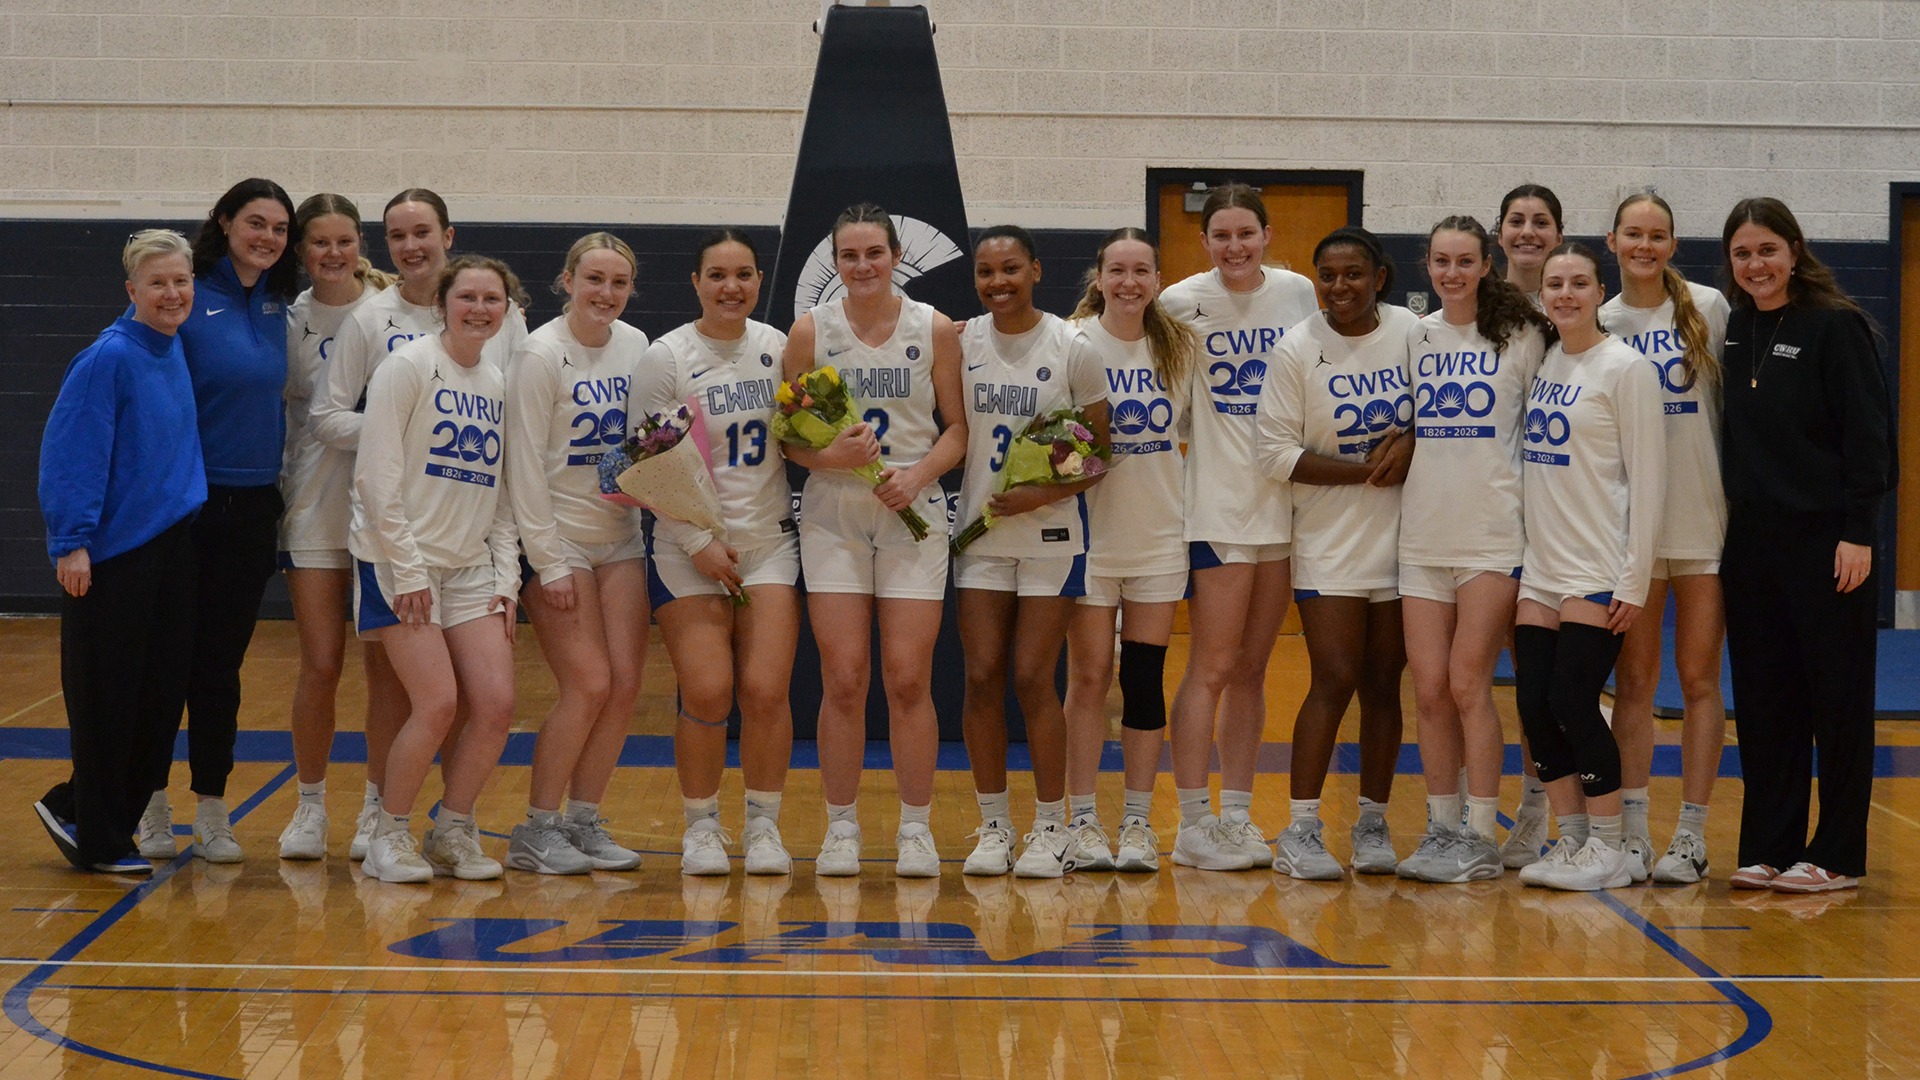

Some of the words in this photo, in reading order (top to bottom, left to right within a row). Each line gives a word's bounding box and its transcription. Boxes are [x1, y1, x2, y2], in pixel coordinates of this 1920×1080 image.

[1206, 327, 1286, 356] CWR
[1622, 328, 1688, 355] WRU
[1773, 343, 1802, 356] CWRU
[1209, 359, 1267, 396] 20
[1328, 365, 1411, 398] CWRU
[1418, 351, 1500, 378] CWRU
[434, 388, 503, 425] CWRU
[572, 374, 631, 406] CWR
[707, 378, 777, 416] CWRU
[974, 383, 1038, 417] CWRU
[1416, 381, 1496, 418] 200
[1226, 404, 1251, 414] 1826
[1334, 393, 1415, 437] 200
[1664, 404, 1682, 413] 026
[429, 420, 501, 466] 200
[569, 408, 627, 447] 20
[726, 419, 768, 467] 13
[863, 408, 890, 455] 2
[1423, 428, 1446, 437] 1826
[1454, 427, 1478, 437] 2026
[1523, 408, 1571, 446] 00
[585, 454, 602, 464] 182
[990, 424, 1012, 473] 3
[1137, 441, 1162, 453] 2026
[1537, 452, 1555, 463] 2026
[386, 917, 1391, 969] UAA
